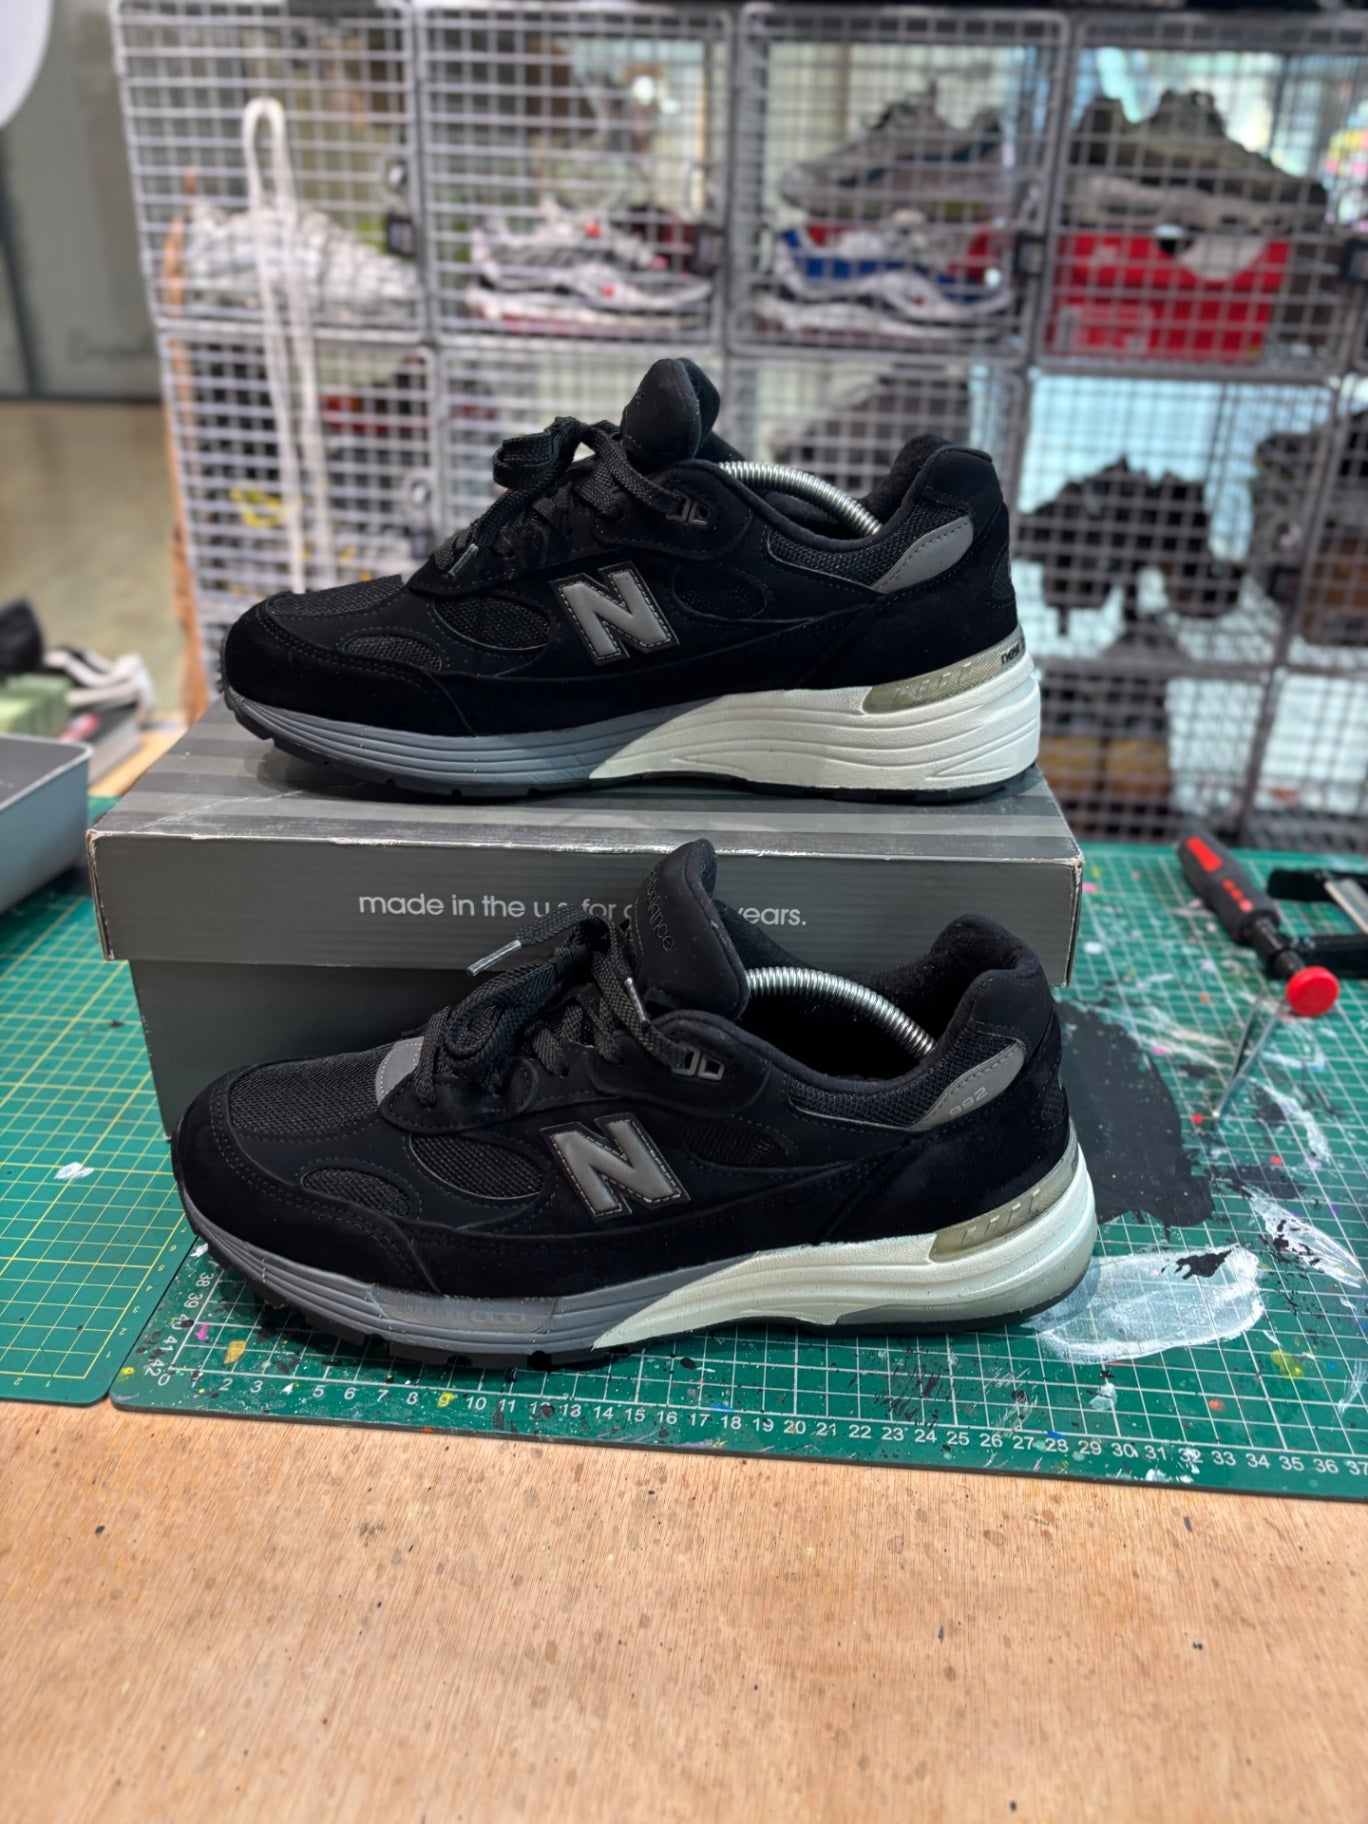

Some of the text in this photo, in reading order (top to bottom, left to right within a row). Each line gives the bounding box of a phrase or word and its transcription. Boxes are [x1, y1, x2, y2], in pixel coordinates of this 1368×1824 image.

[558, 569, 672, 660] N
[359, 893, 445, 916] made
[451, 895, 475, 916] in
[481, 895, 526, 918] the
[581, 898, 617, 920] for
[738, 907, 807, 926] ears.
[551, 1119, 682, 1217] N
[195, 1272, 214, 1287] 38
[183, 1292, 203, 1308] 39
[118, 1327, 128, 1336] 2
[158, 1335, 178, 1352] 41
[144, 1358, 165, 1377] 42
[157, 1374, 170, 1387] 0
[218, 1377, 233, 1391] 2
[250, 1380, 264, 1394] 3
[312, 1385, 327, 1398] 5
[343, 1387, 358, 1400] 6
[376, 1389, 389, 1402] 7
[406, 1391, 419, 1405] 8
[466, 1396, 487, 1410] 10
[499, 1399, 516, 1413] 11
[530, 1401, 552, 1416] 1
[561, 1403, 582, 1418] 13
[593, 1405, 614, 1420] 14
[625, 1408, 646, 1422] 15
[657, 1410, 678, 1425] 16
[690, 1413, 710, 1427] 17
[721, 1415, 742, 1430] 18
[753, 1417, 774, 1432] 19
[783, 1419, 806, 1434] 20
[815, 1421, 837, 1437] 21
[848, 1424, 872, 1439] 22
[881, 1426, 905, 1441] 23
[914, 1428, 938, 1443] 24
[946, 1431, 970, 1446] 25
[979, 1433, 1003, 1448] 26
[1012, 1435, 1035, 1450] 27
[1044, 1438, 1069, 1453] 28
[1078, 1440, 1102, 1455] 29
[1111, 1442, 1138, 1458] 30
[1144, 1444, 1167, 1460] 31
[1211, 1450, 1237, 1466] 33
[1245, 1453, 1270, 1469] 34
[1279, 1455, 1305, 1471] 35
[1312, 1458, 1339, 1474] 36
